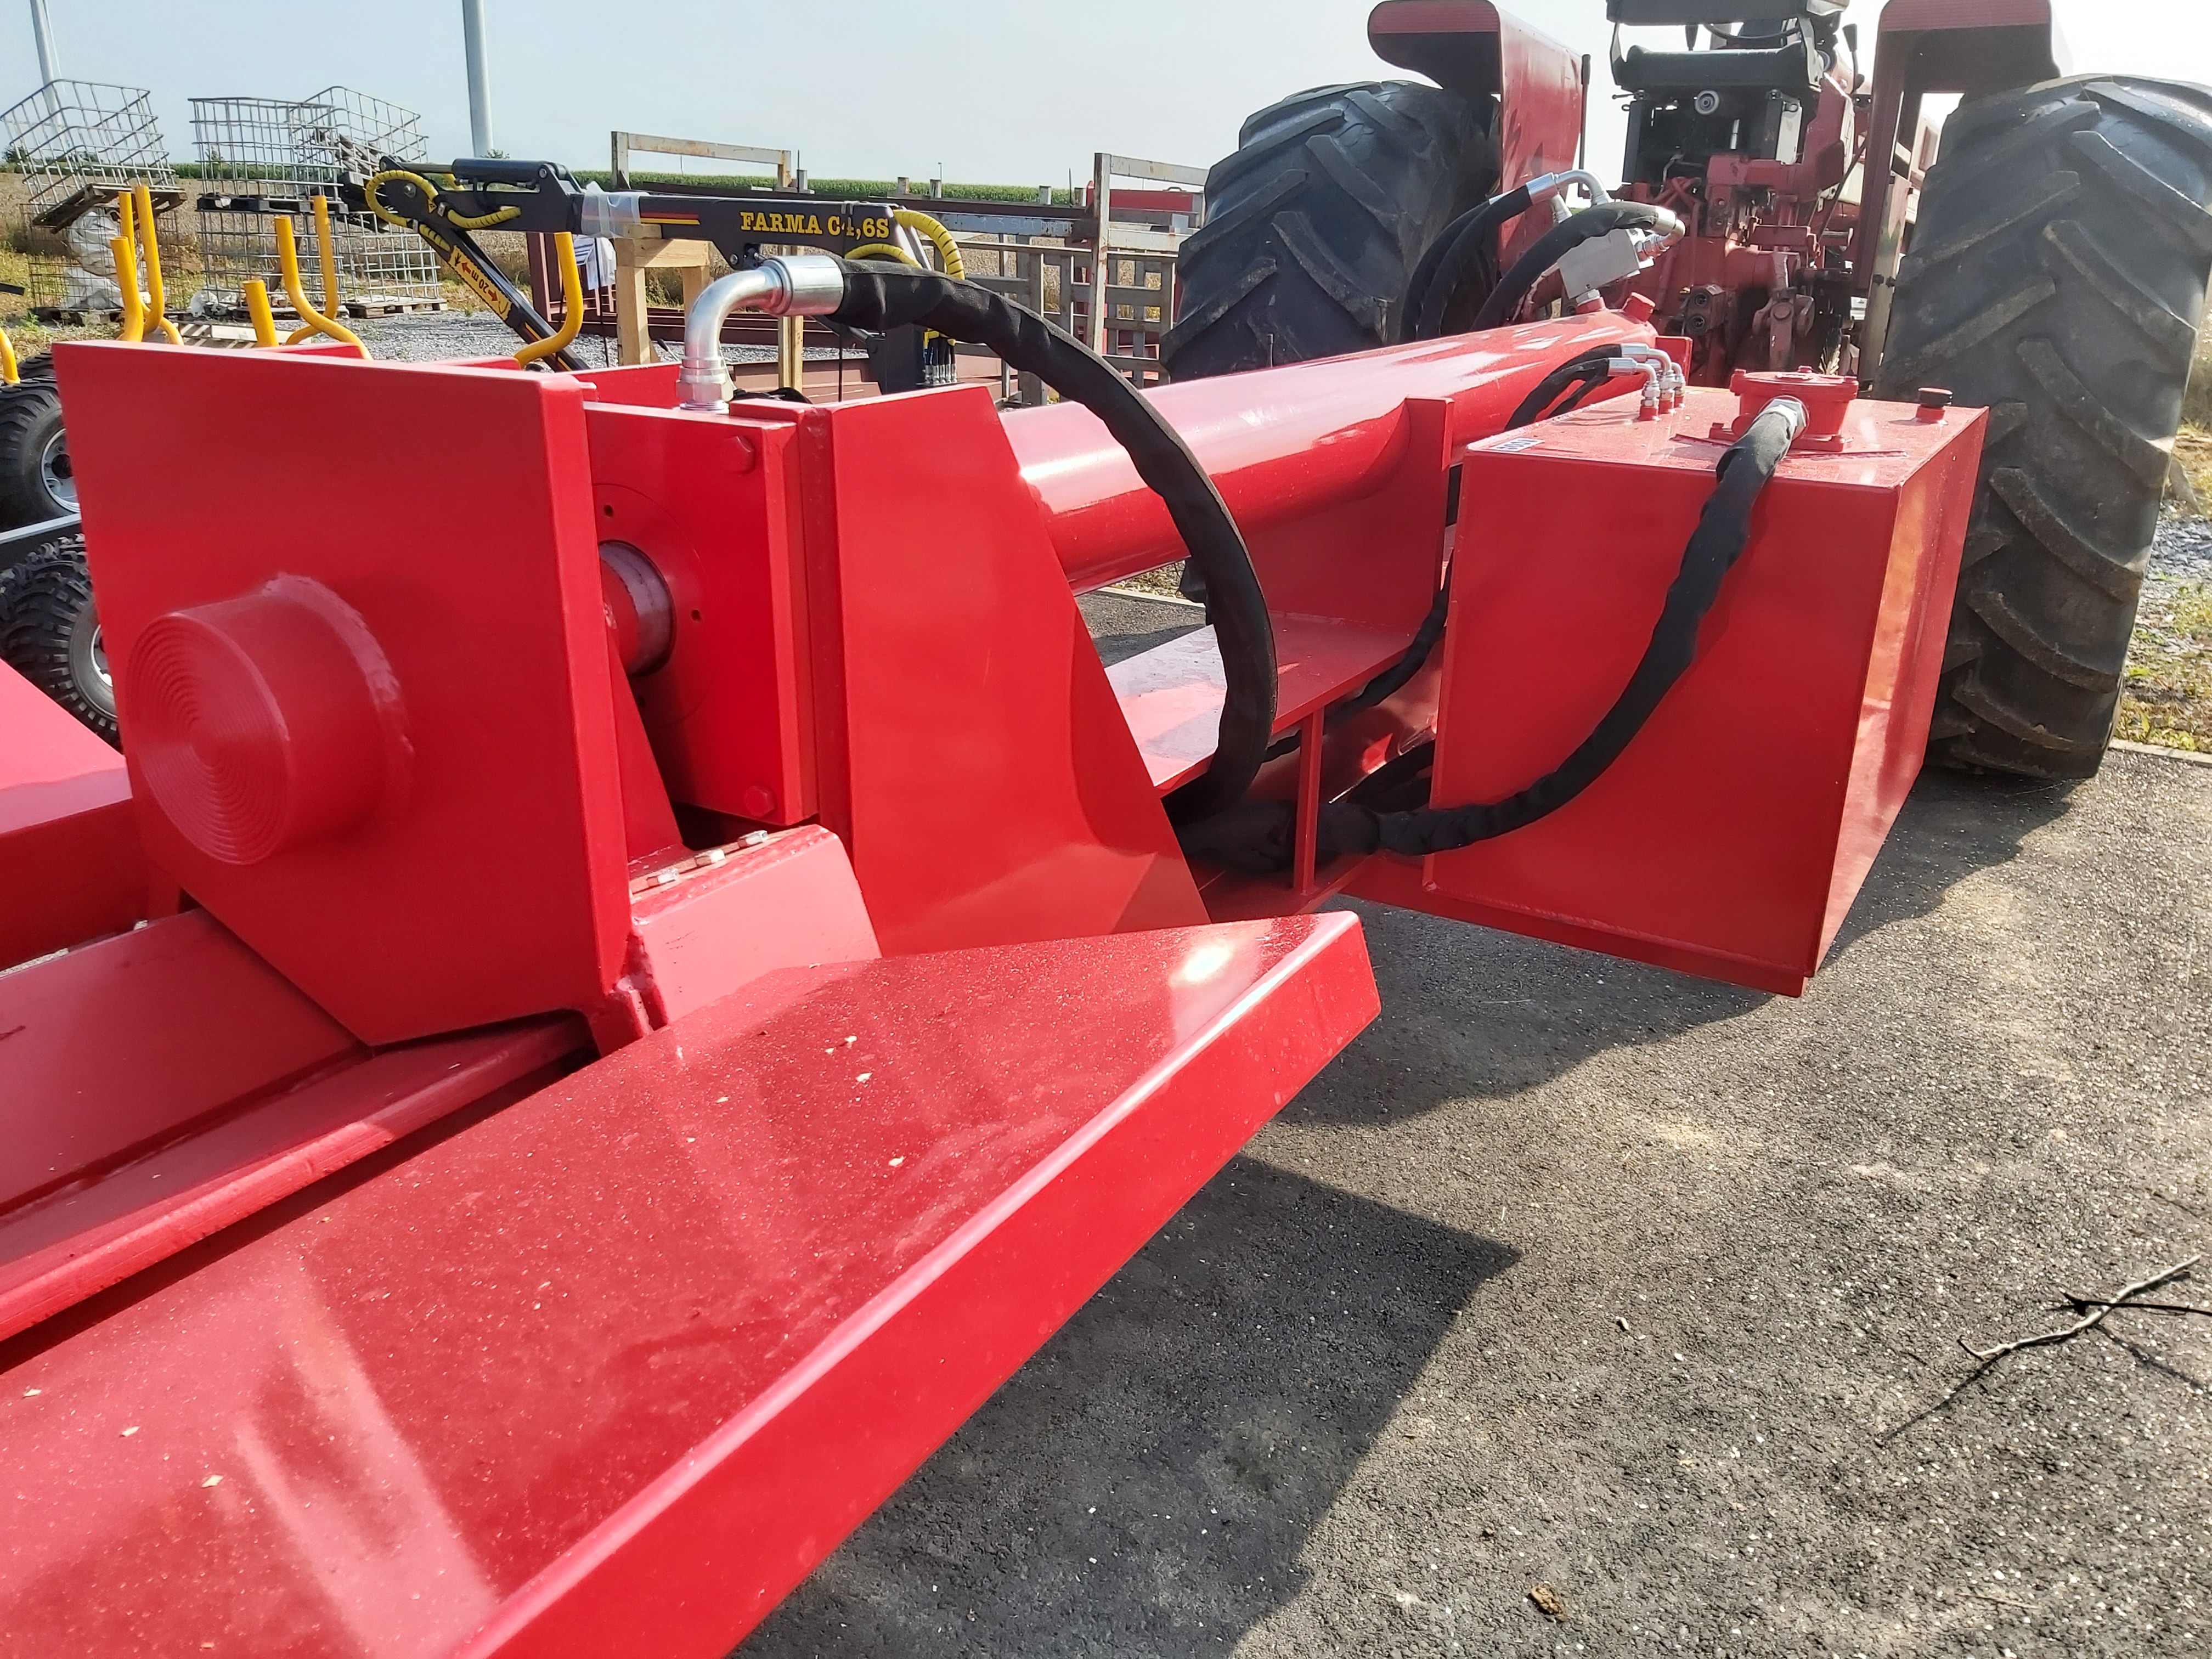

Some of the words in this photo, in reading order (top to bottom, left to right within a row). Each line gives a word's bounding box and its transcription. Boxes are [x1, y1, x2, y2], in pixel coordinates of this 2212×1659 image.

[740, 211, 823, 235] FARMA
[471, 269, 479, 282] m
[478, 279, 489, 294] 20
